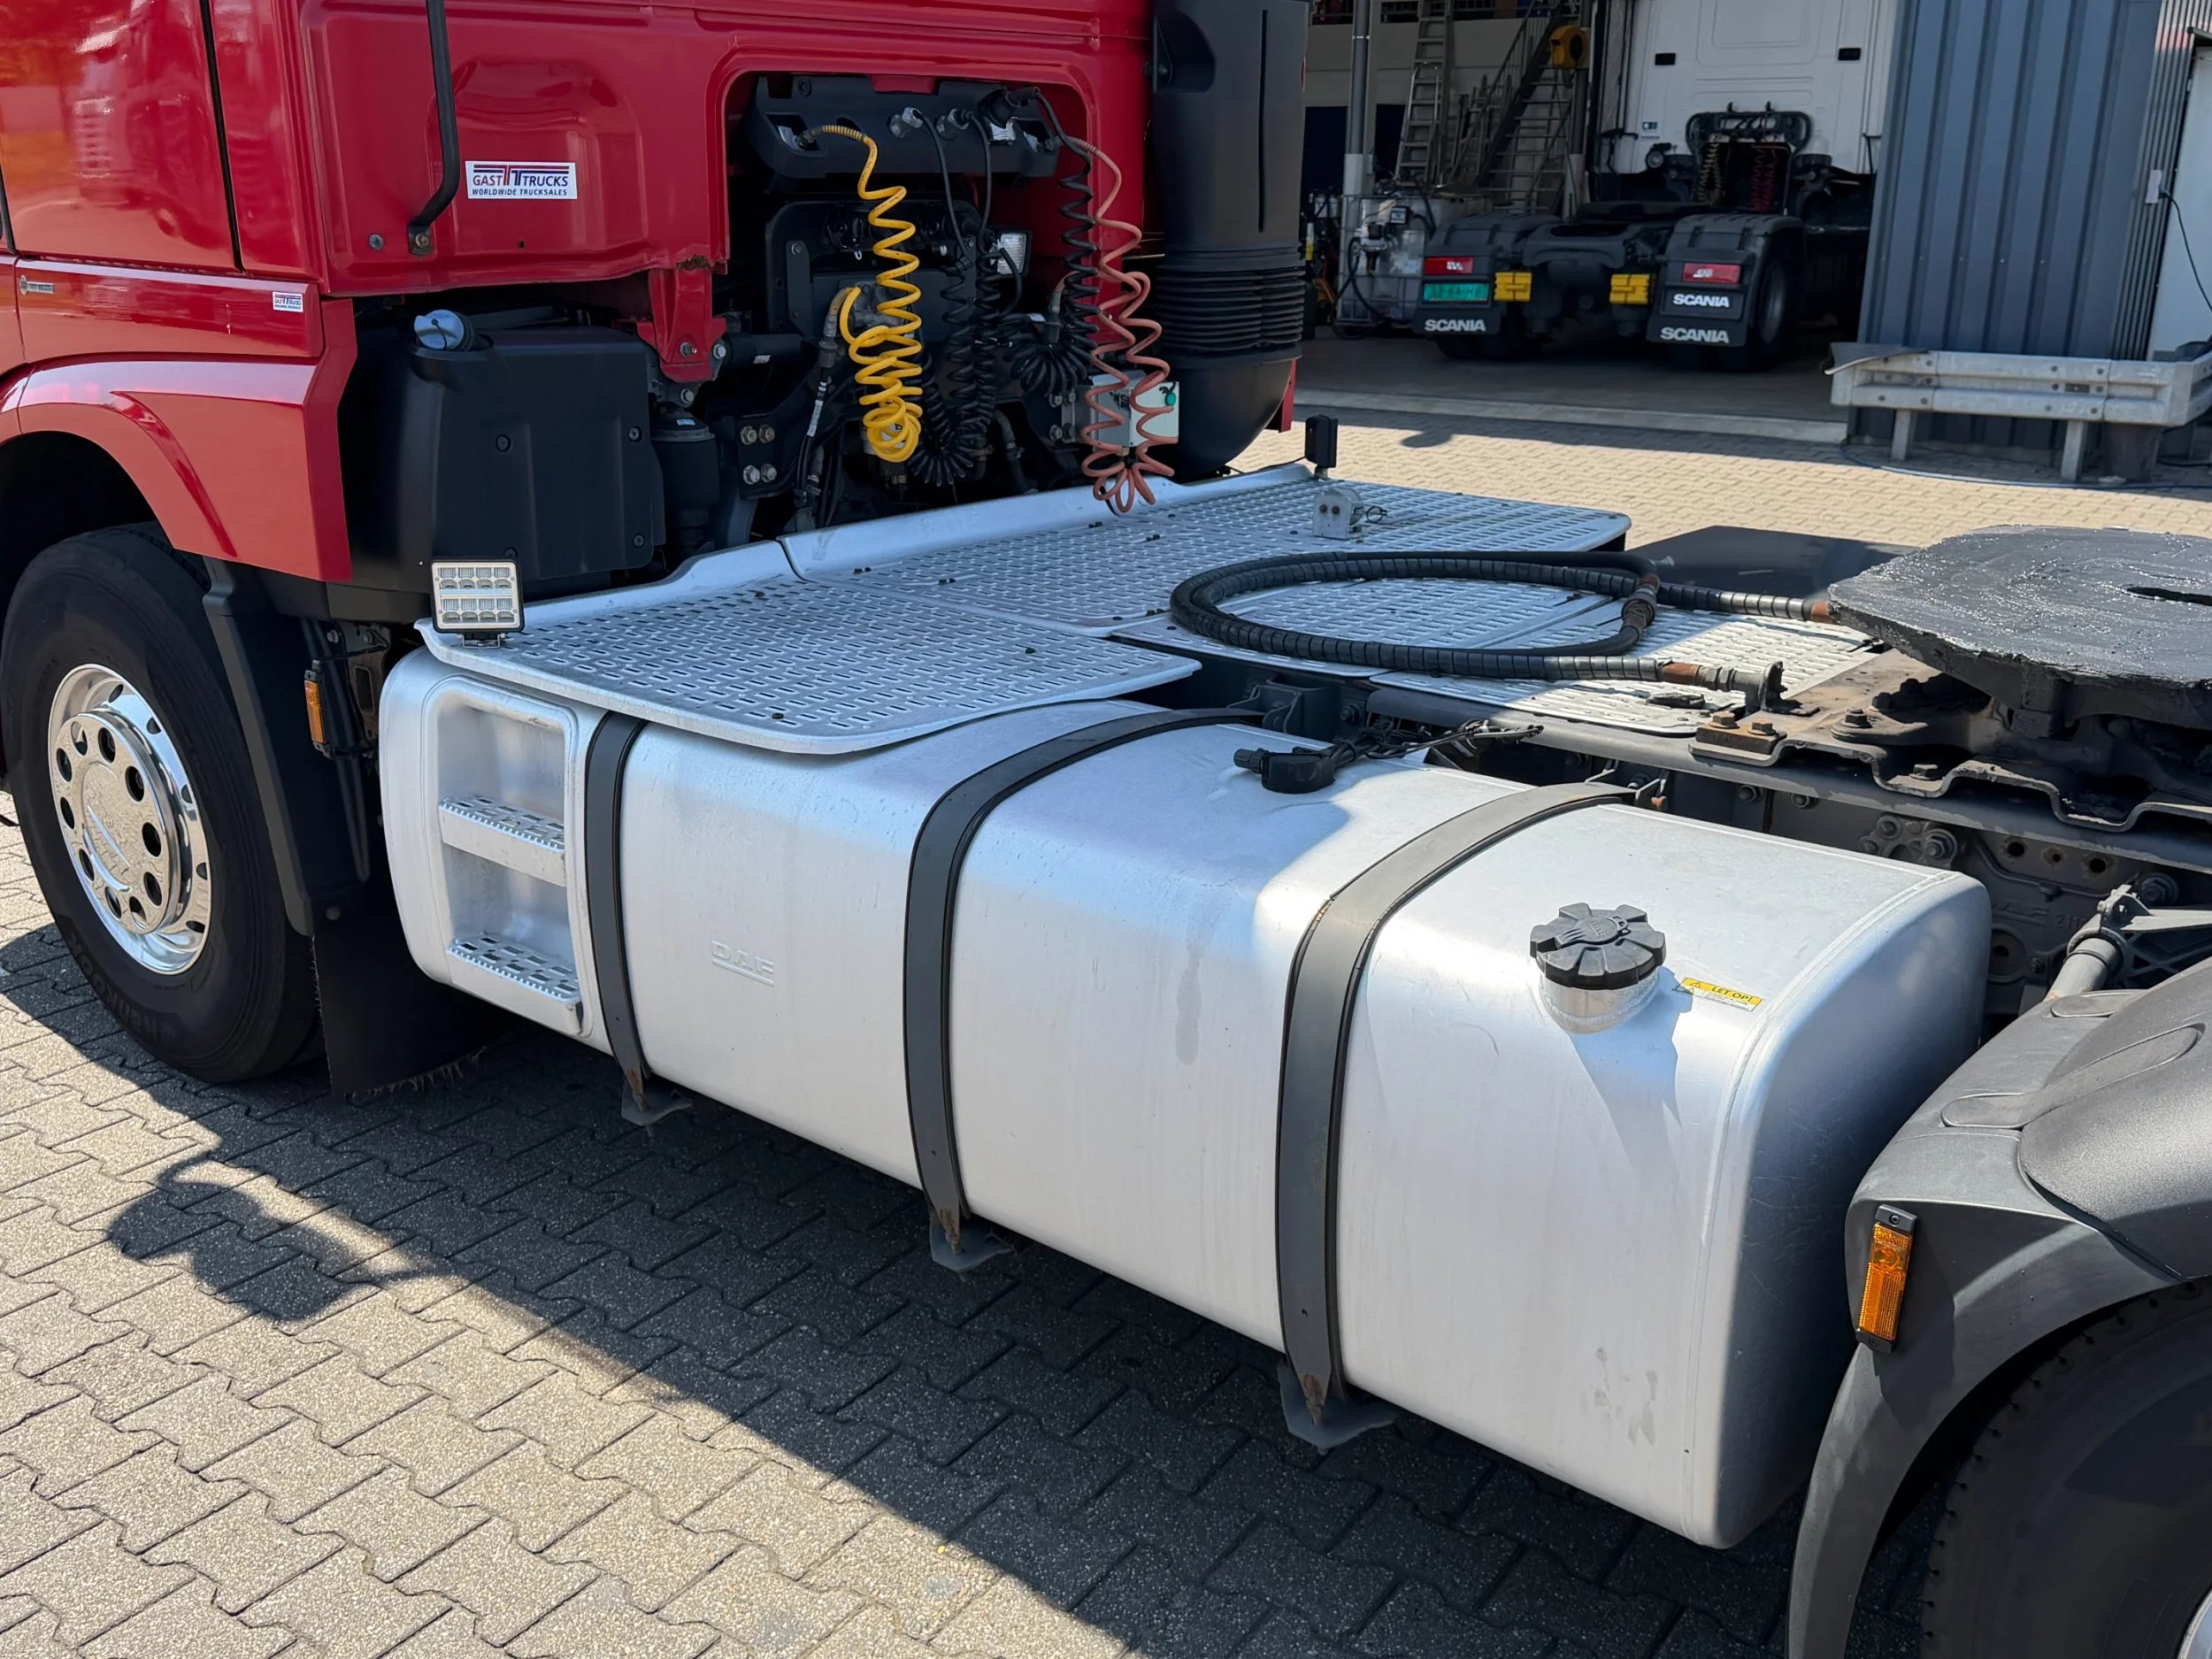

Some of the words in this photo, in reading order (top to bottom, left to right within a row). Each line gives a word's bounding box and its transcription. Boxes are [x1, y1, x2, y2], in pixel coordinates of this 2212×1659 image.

[472, 175, 503, 187] GAST
[523, 175, 569, 187] TRUCKS
[1673, 293, 1730, 308] SCANIA
[1424, 319, 1486, 332] SCANIA
[1660, 326, 1730, 343] SCANIA
[710, 940, 774, 975] DAF
[1711, 986, 1730, 995] LET
